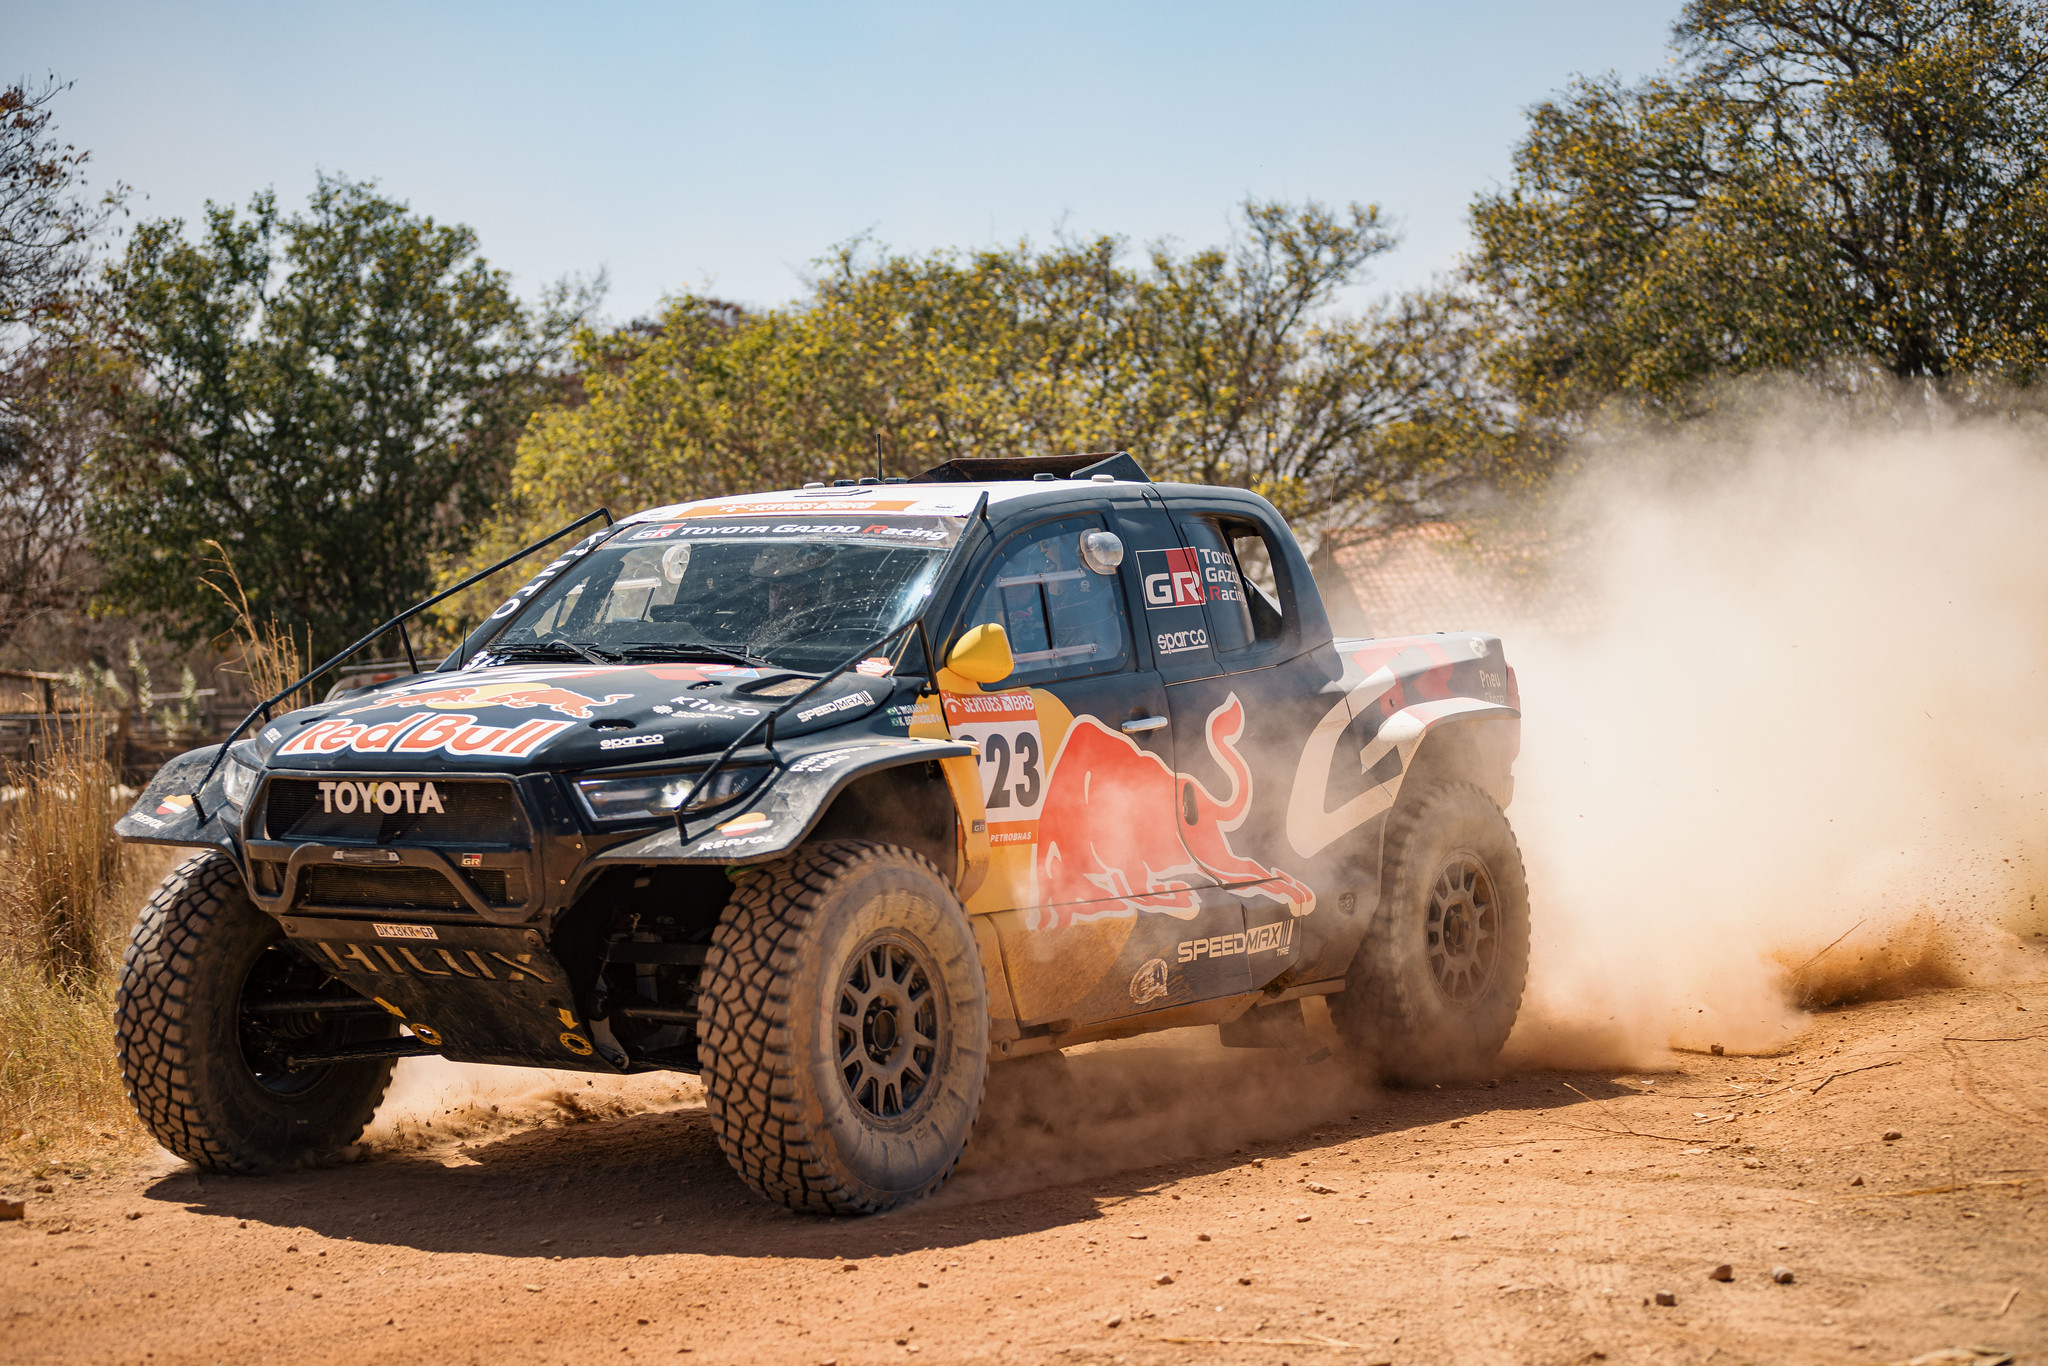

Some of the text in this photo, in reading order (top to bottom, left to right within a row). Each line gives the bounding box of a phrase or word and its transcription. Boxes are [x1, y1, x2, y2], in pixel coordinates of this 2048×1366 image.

[633, 524, 949, 541] GR TOYOTA GAZOO Racing
[1144, 571, 1203, 605] GR
[1157, 628, 1208, 655] sparco
[1479, 669, 1501, 689] Pneu
[1012, 694, 1035, 711] BRB
[317, 781, 446, 814] TOYOTA
[990, 831, 1032, 843] PETROBRAS
[462, 857, 480, 866] GR
[419, 926, 434, 938] GP
[1276, 946, 1290, 957] TIRE
